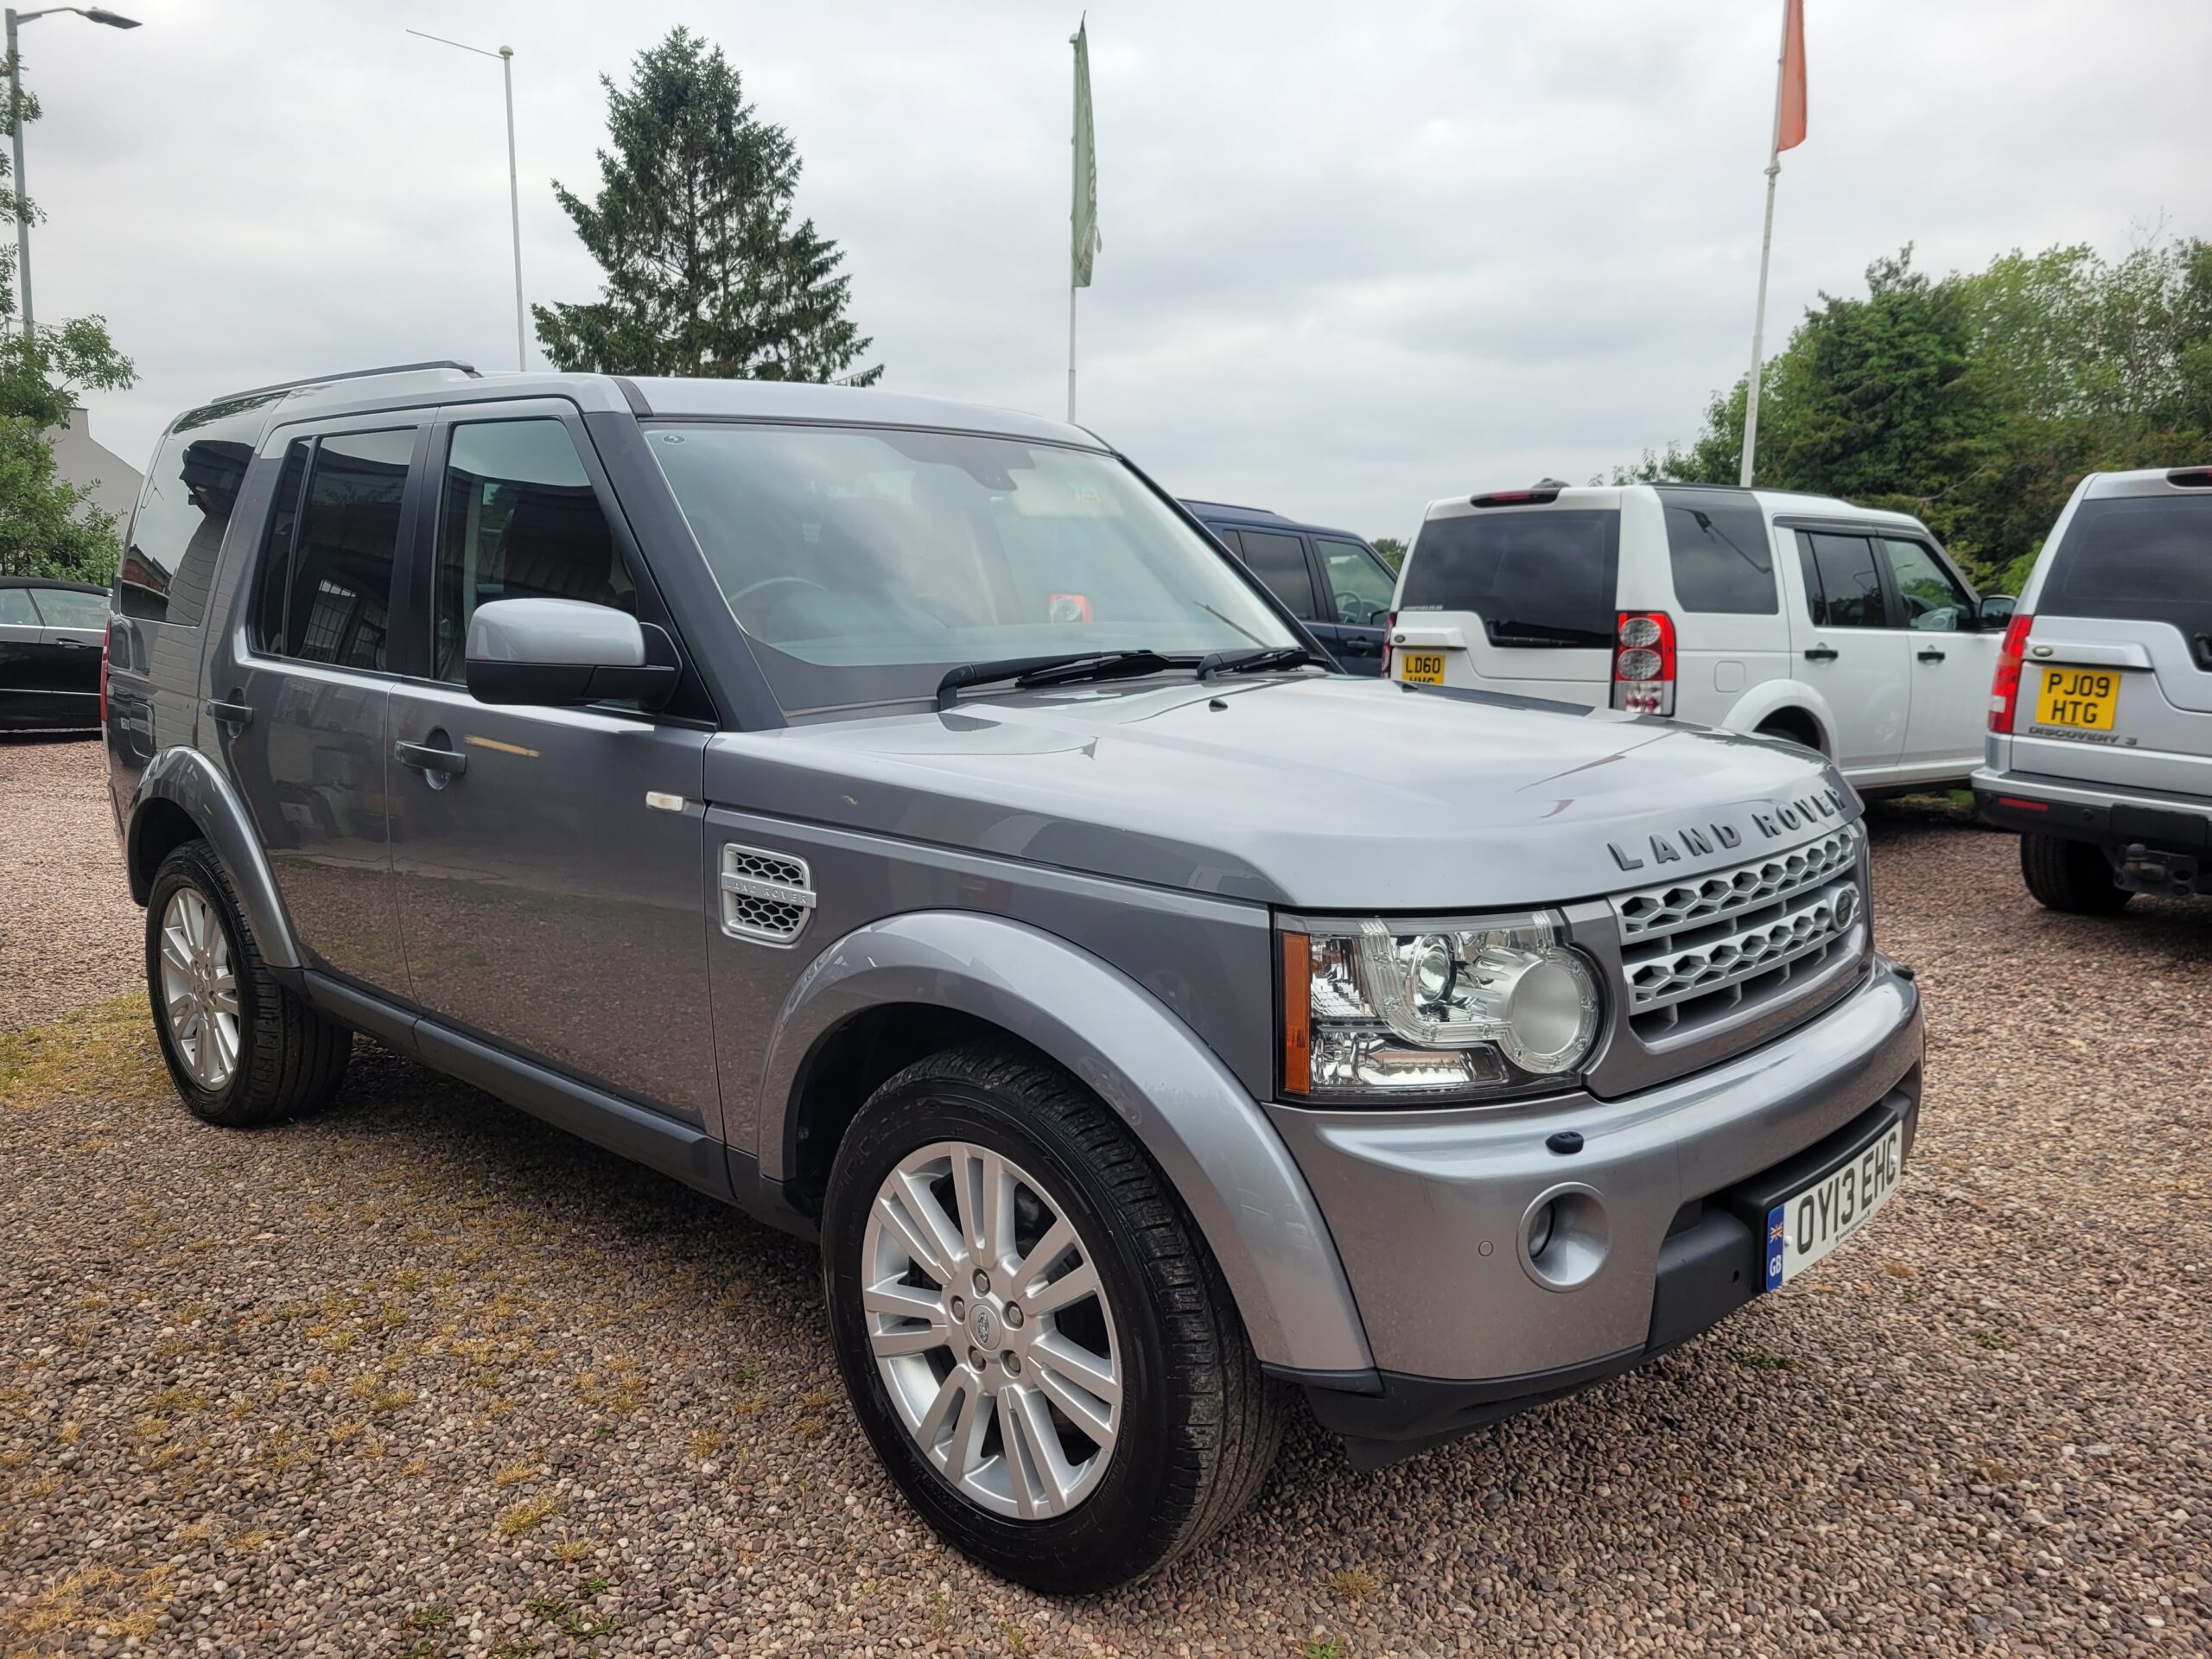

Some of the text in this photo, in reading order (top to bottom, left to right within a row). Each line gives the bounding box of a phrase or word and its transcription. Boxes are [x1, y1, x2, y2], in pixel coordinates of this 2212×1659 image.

[1405, 657, 1440, 674] LD60
[2047, 673, 2110, 698] PJ09
[2051, 699, 2098, 724] HTG
[2029, 727, 2120, 743] DISCOVERY
[1606, 786, 1847, 871] LAND ROVER
[1797, 1166, 1855, 1255] OY13
[1769, 1254, 1782, 1277] GB
